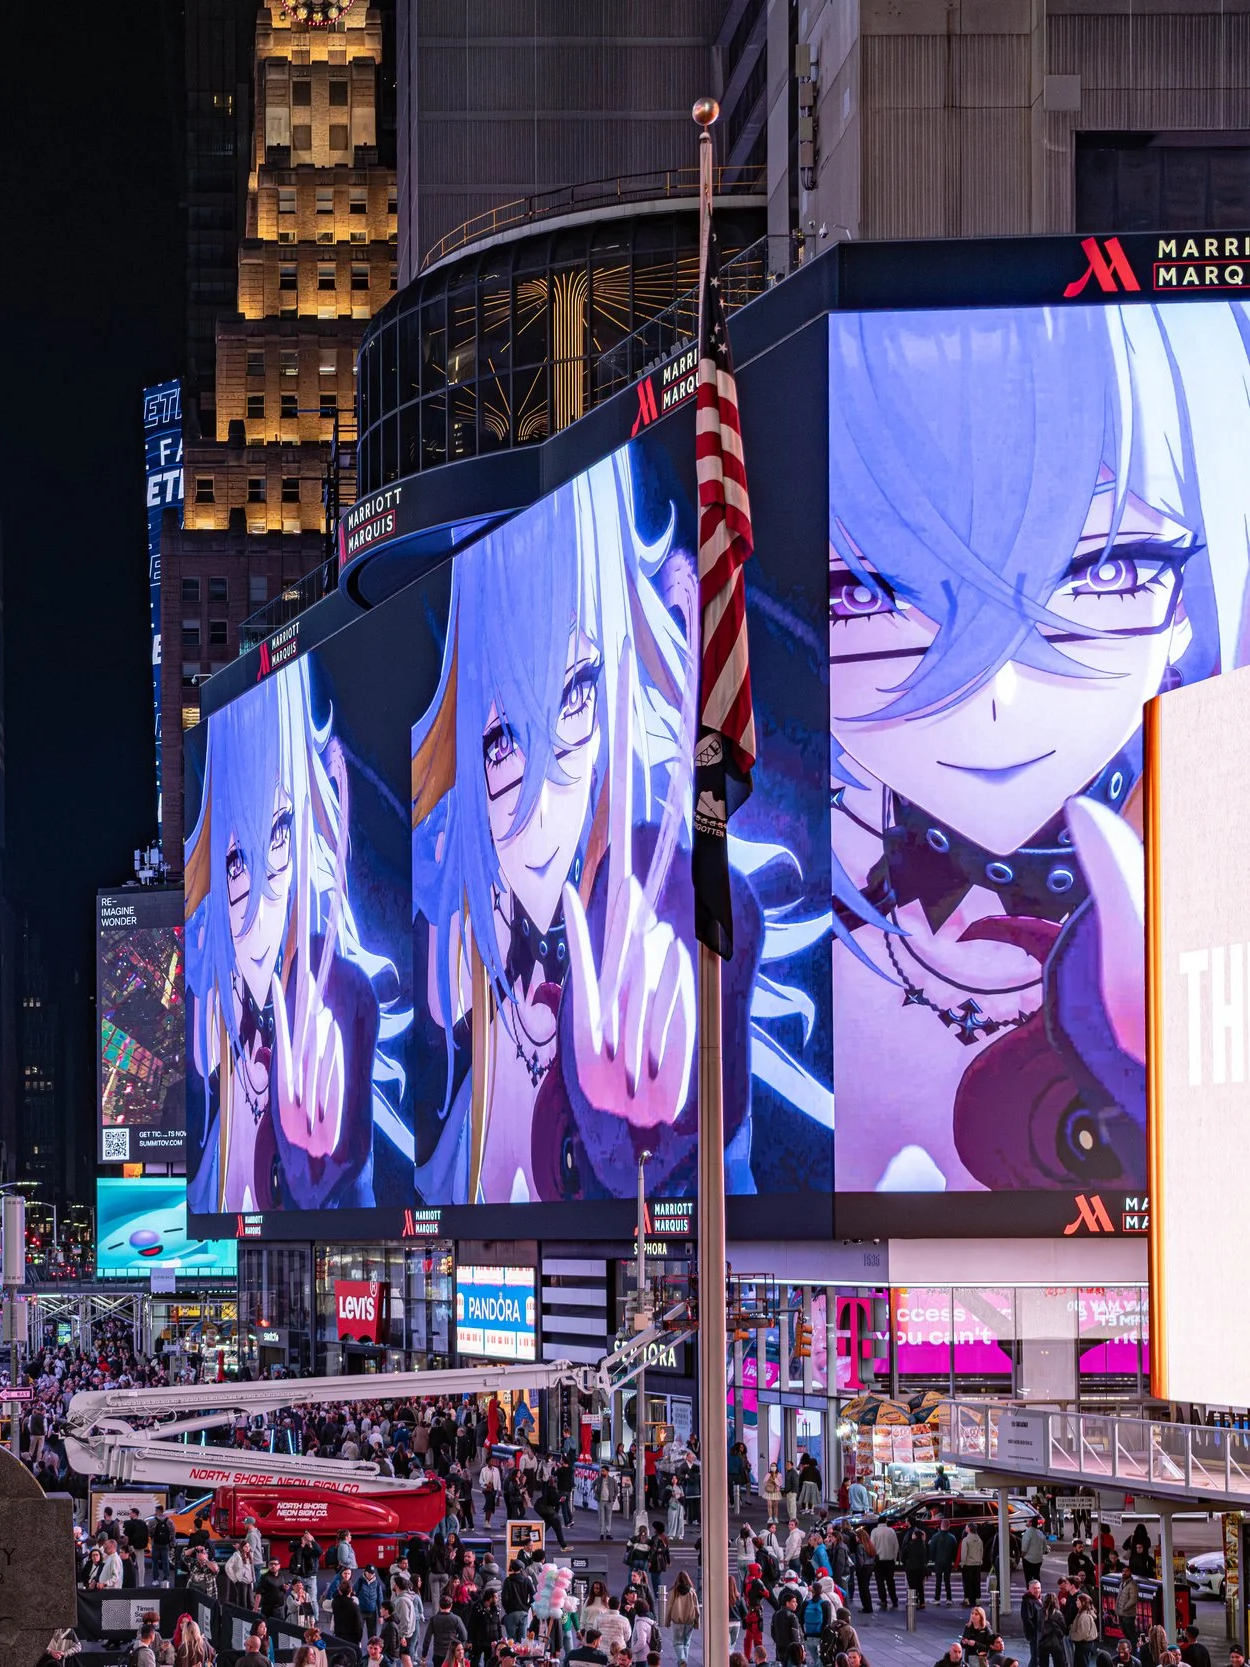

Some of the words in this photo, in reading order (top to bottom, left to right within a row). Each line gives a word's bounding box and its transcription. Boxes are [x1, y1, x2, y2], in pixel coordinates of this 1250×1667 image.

[1158, 265, 1244, 286] MARQ
[348, 487, 402, 531] MARRIOTT
[348, 515, 393, 554] MARQUIS
[271, 621, 300, 650] MARRIOTT
[271, 641, 297, 667] MARQUIS
[101, 907, 135, 916] IMAGINE
[101, 917, 137, 927] WONDER
[415, 1210, 441, 1221] MARRIOTT
[654, 1202, 693, 1215] MARRIOTT
[415, 1223, 438, 1234] MARQUIS
[654, 1219, 689, 1232] MARQUIS
[634, 1243, 667, 1255] SPHORA
[929, 1327, 992, 1345] can't
[190, 1468, 231, 1482] NORTH
[233, 1473, 273, 1486] SHORE
